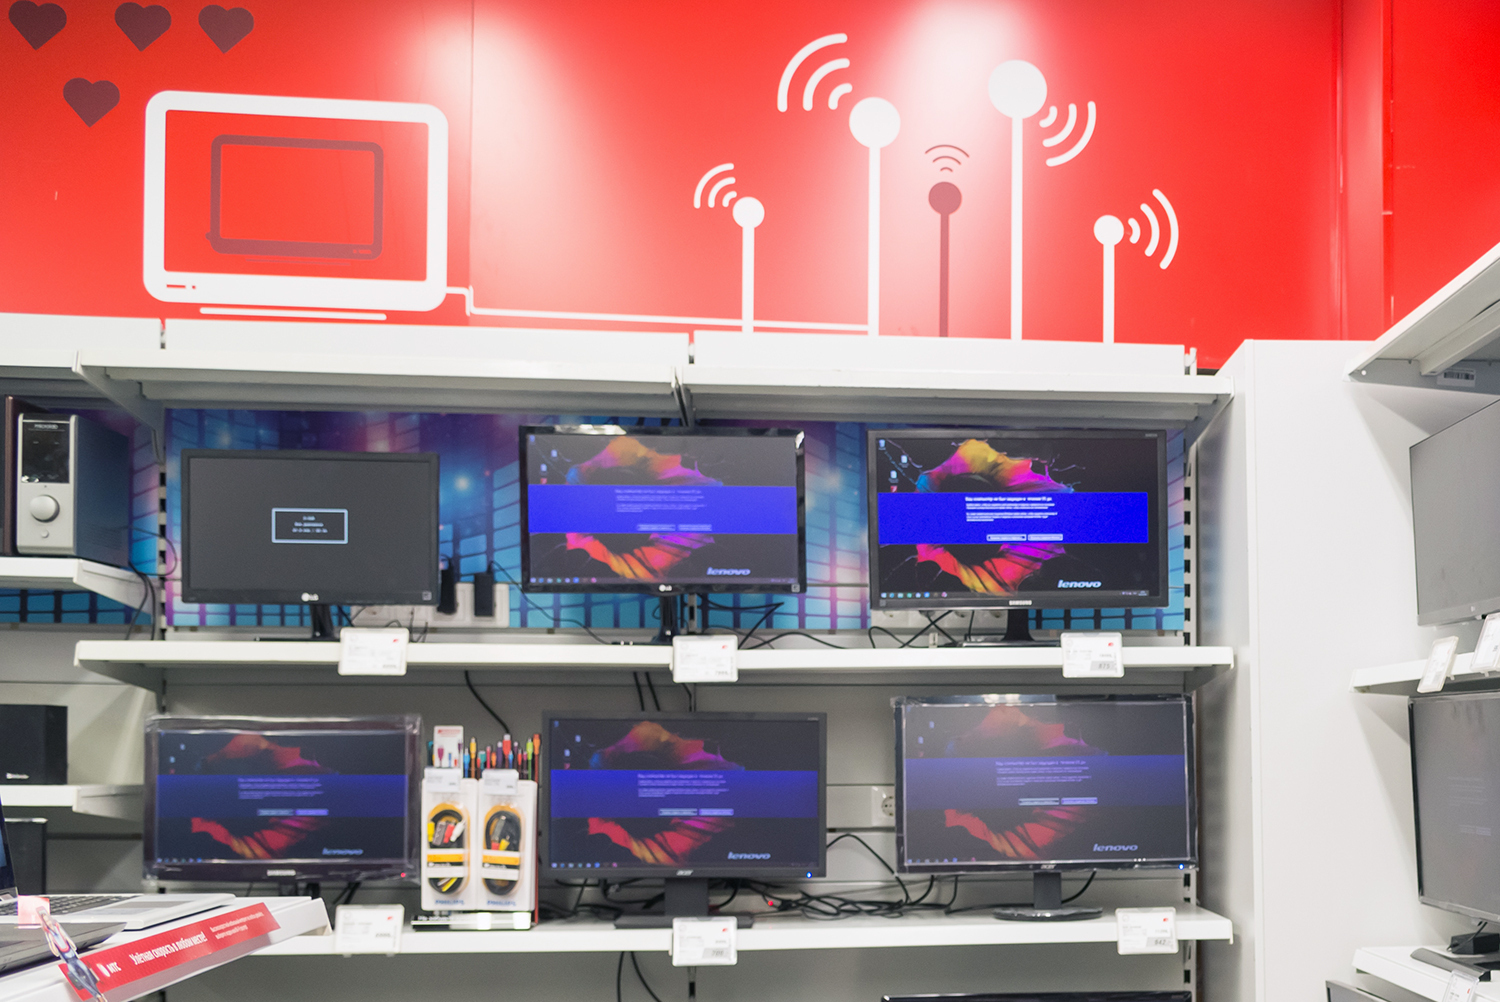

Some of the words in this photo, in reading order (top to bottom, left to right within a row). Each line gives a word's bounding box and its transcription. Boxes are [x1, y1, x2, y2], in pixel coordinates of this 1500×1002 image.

[706, 567, 751, 576] lenovo
[1057, 579, 1102, 589] lenovo
[1093, 843, 1139, 852] lenovo
[727, 851, 771, 860] lenovo
